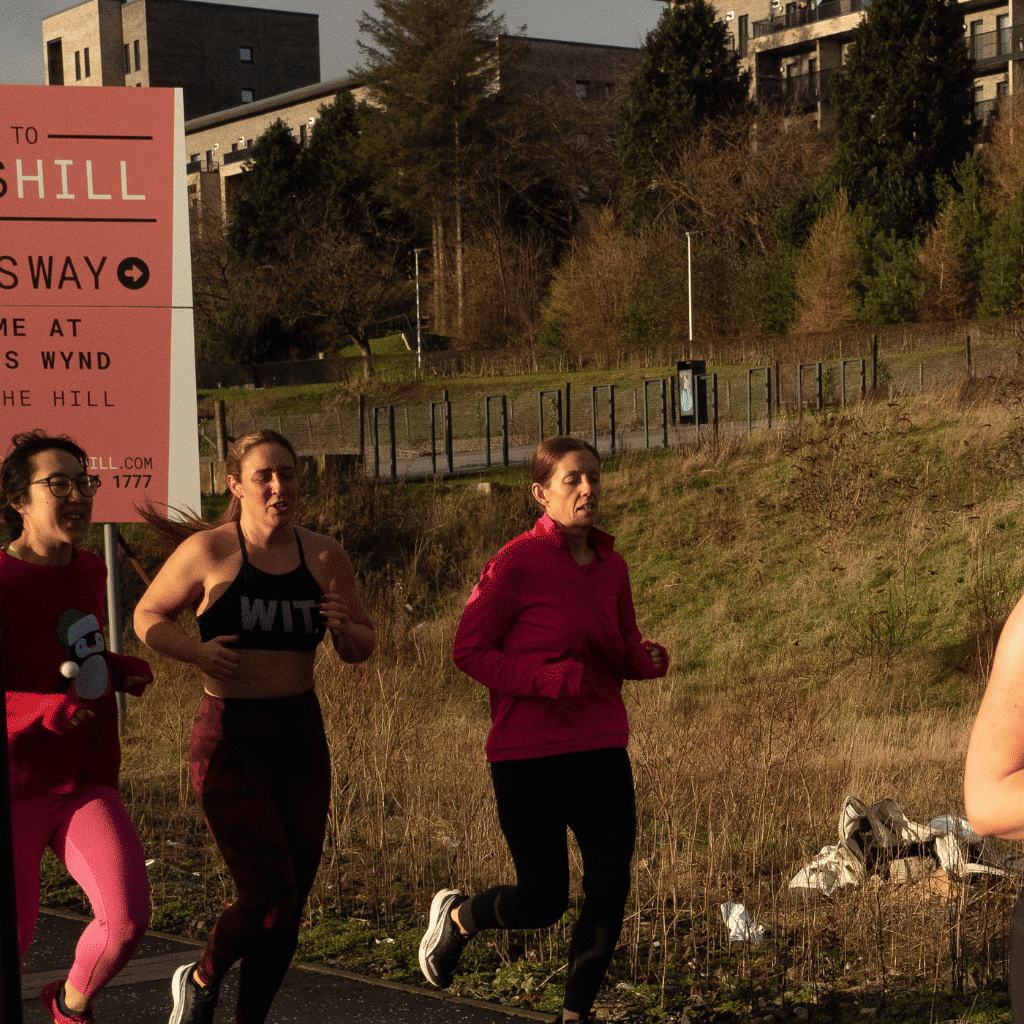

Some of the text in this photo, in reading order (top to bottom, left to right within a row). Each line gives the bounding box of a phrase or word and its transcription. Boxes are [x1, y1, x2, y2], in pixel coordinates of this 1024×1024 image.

[11, 126, 38, 144] TO
[0, 255, 107, 290] SWAY
[50, 318, 82, 337] AT
[41, 351, 111, 370] WYND
[54, 390, 115, 407] HILL
[113, 474, 152, 488] 1777
